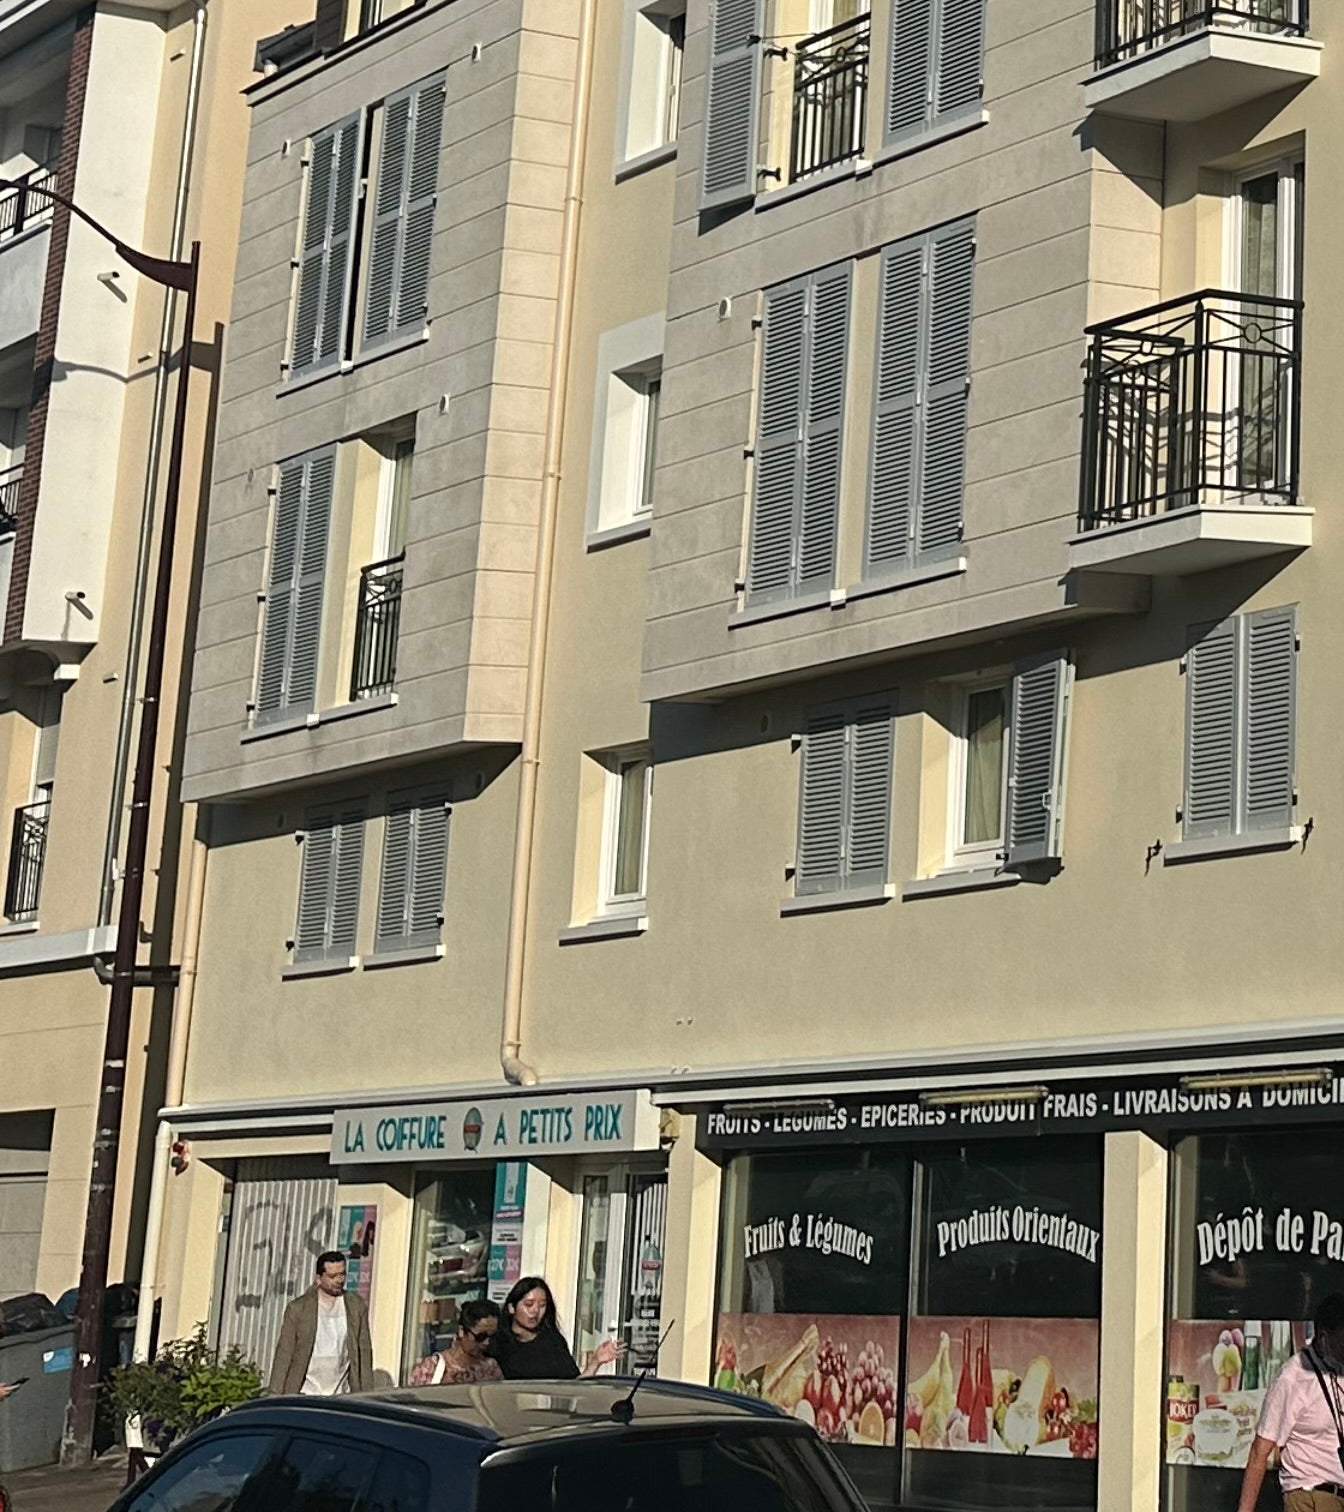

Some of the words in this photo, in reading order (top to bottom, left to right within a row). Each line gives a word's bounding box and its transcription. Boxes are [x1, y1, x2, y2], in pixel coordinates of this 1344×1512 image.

[345, 1121, 364, 1152] LA
[376, 1116, 447, 1151] COIFFURE
[494, 1112, 507, 1146] A
[519, 1107, 572, 1144] PETITS
[584, 1104, 623, 1141] PRIX
[707, 1113, 761, 1135] FRUITS
[861, 1103, 946, 1128] EPICERIES
[960, 1101, 1035, 1124] PRODUIT
[1043, 1093, 1097, 1117] FRAIS
[1113, 1087, 1231, 1115] LIVRAISONS
[743, 1215, 786, 1259] Fruits
[789, 1213, 802, 1247] &
[806, 1212, 874, 1265] Légumes
[937, 1205, 1010, 1257] Produits
[1012, 1205, 1101, 1264] Orientaux
[1197, 1207, 1264, 1266] Dépôt
[1276, 1208, 1304, 1252] de
